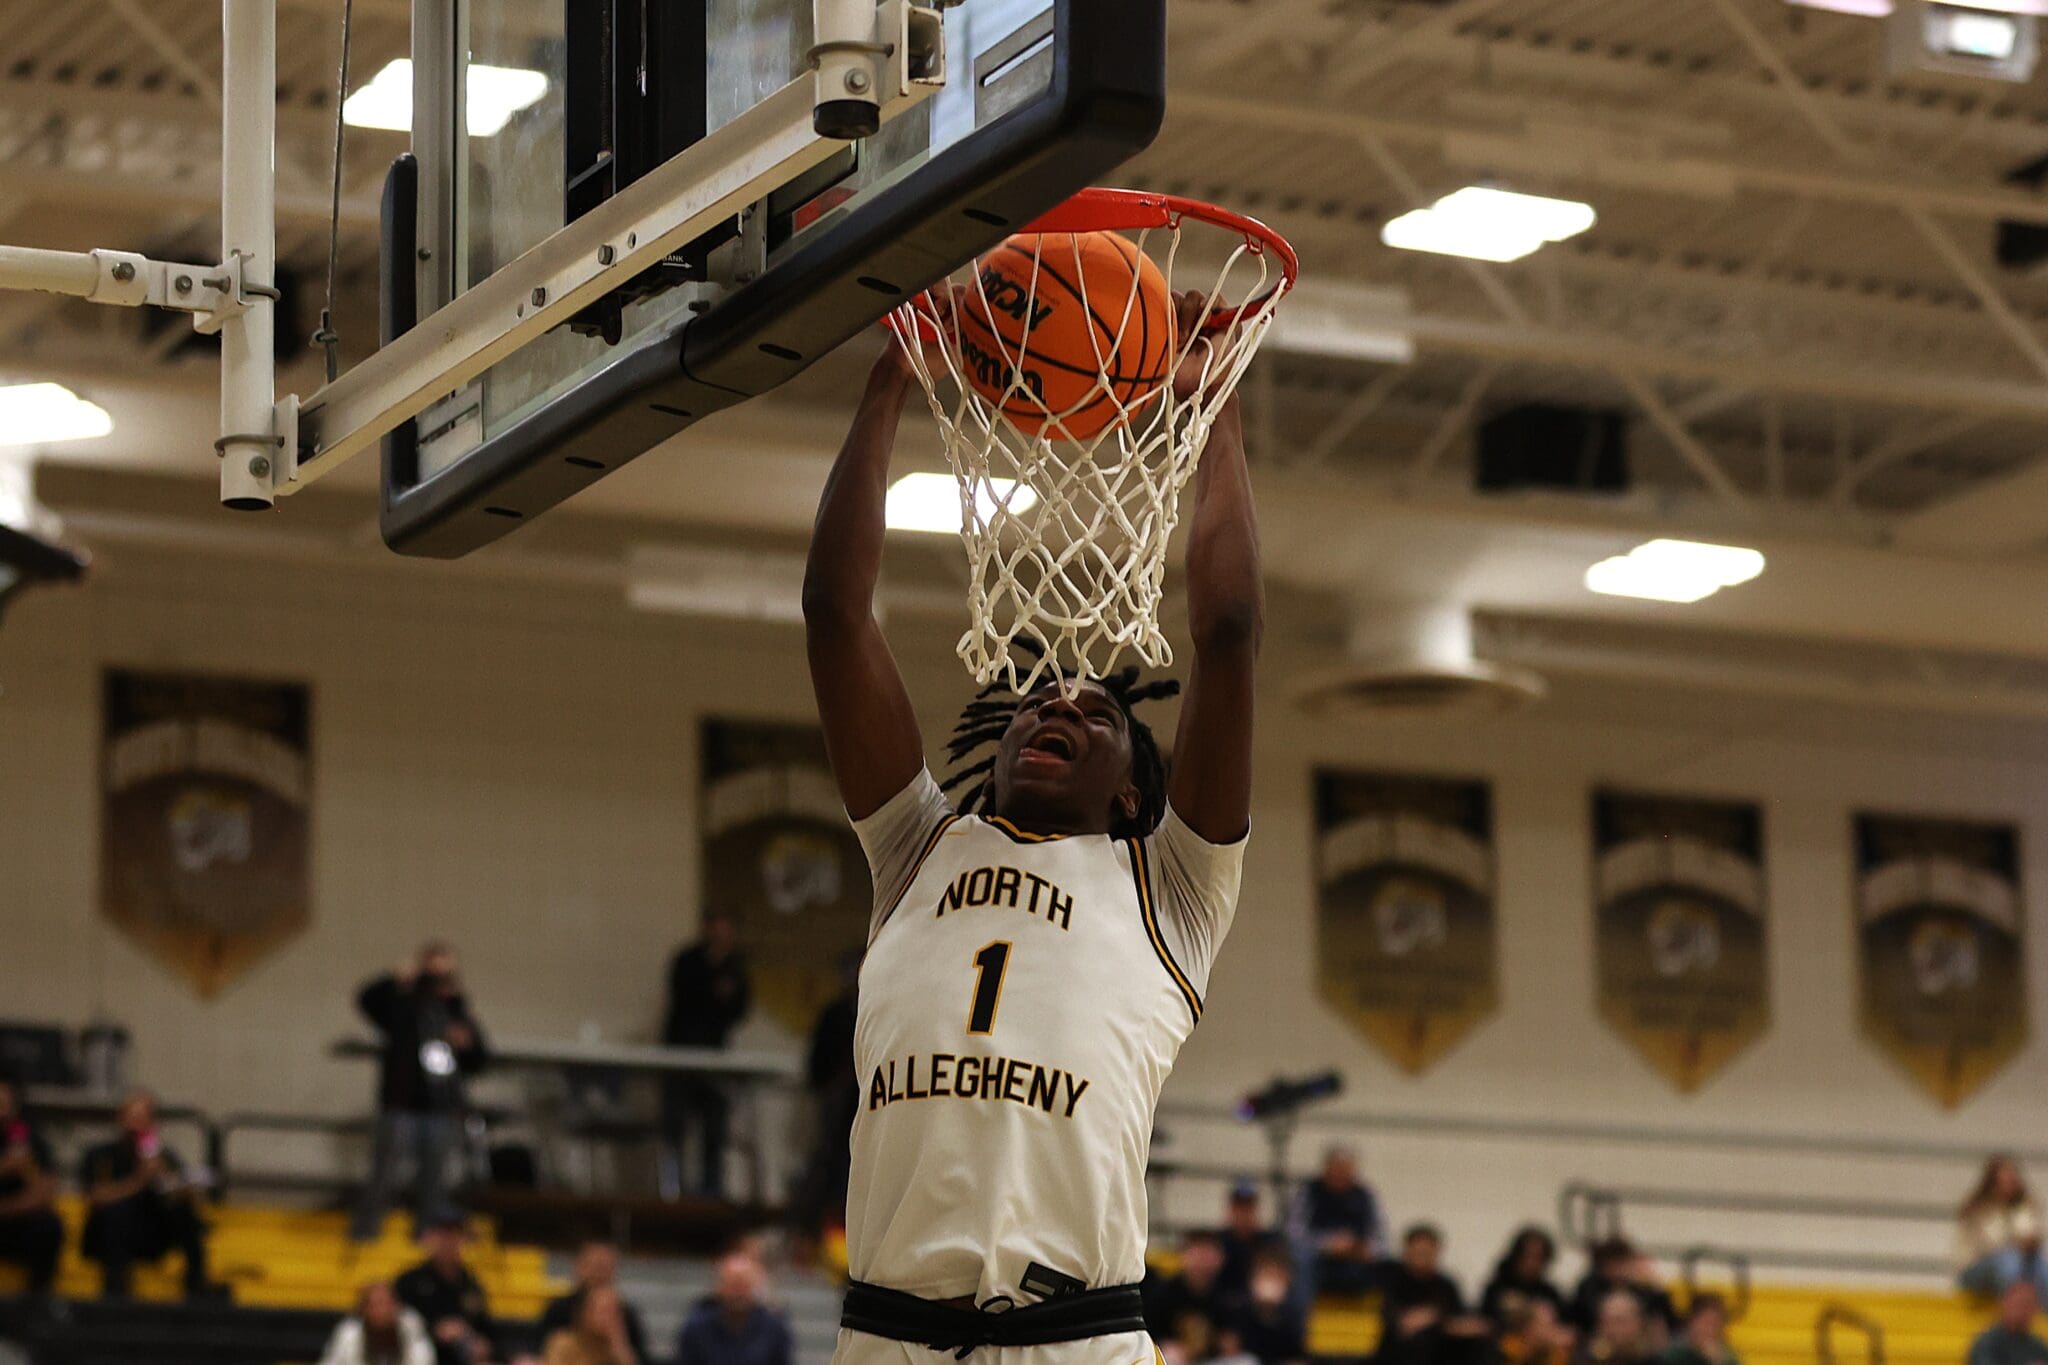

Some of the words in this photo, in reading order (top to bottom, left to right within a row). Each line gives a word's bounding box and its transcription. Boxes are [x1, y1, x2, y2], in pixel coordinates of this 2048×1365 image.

[935, 866, 1074, 931] NORTH
[966, 939, 1013, 1036] 1
[869, 1054, 1090, 1118] ALLEGHENY
